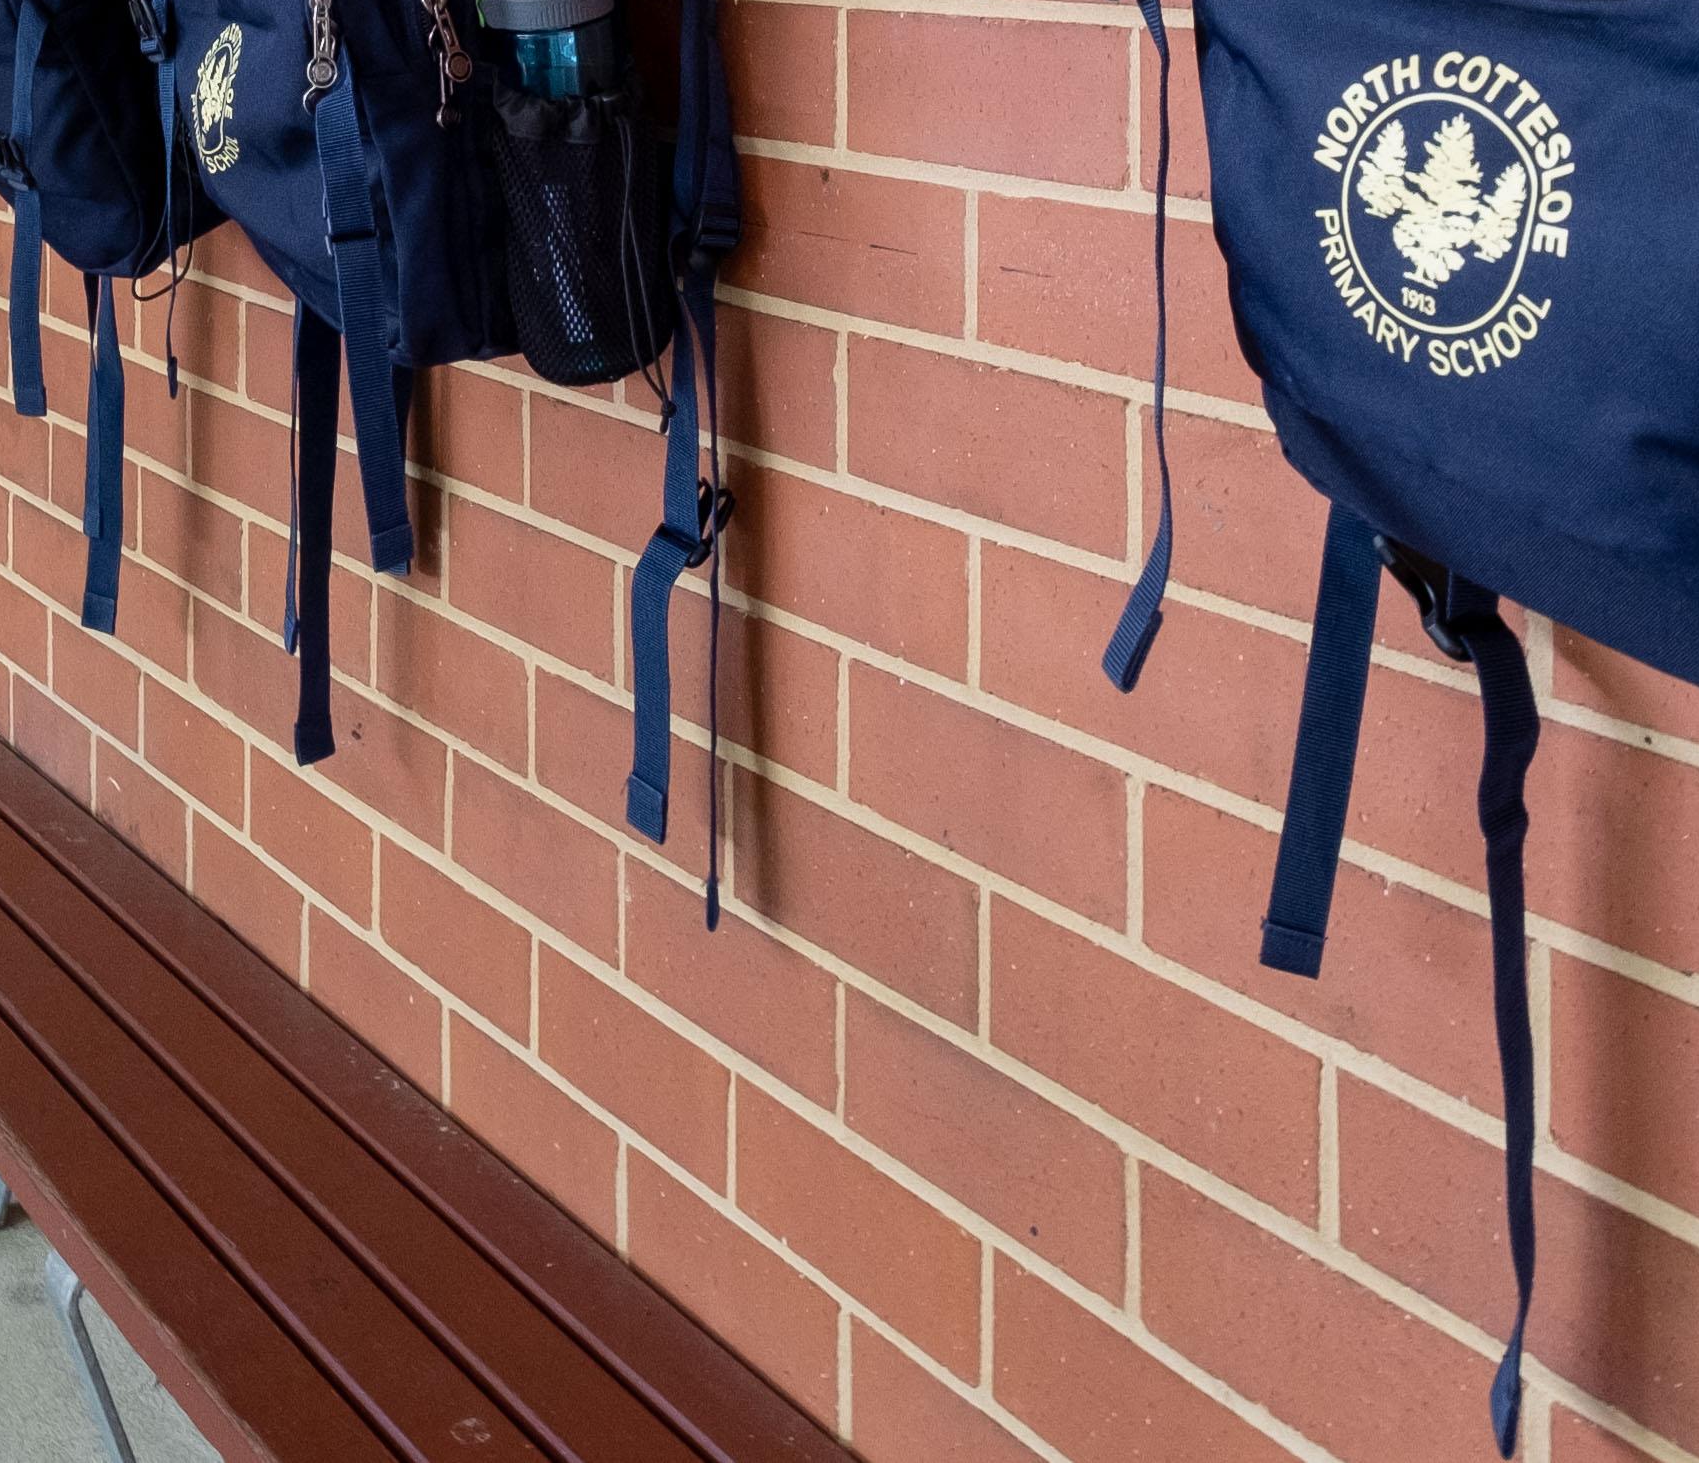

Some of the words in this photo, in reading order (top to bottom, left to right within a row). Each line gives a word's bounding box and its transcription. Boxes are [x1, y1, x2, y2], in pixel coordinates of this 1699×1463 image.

[1313, 54, 1421, 173] NORTH
[1433, 51, 1575, 259] COTTESLOE
[1314, 208, 1421, 364] PRIMARY
[1427, 293, 1552, 378] SCHOOL
[1401, 286, 1437, 316] 1913
